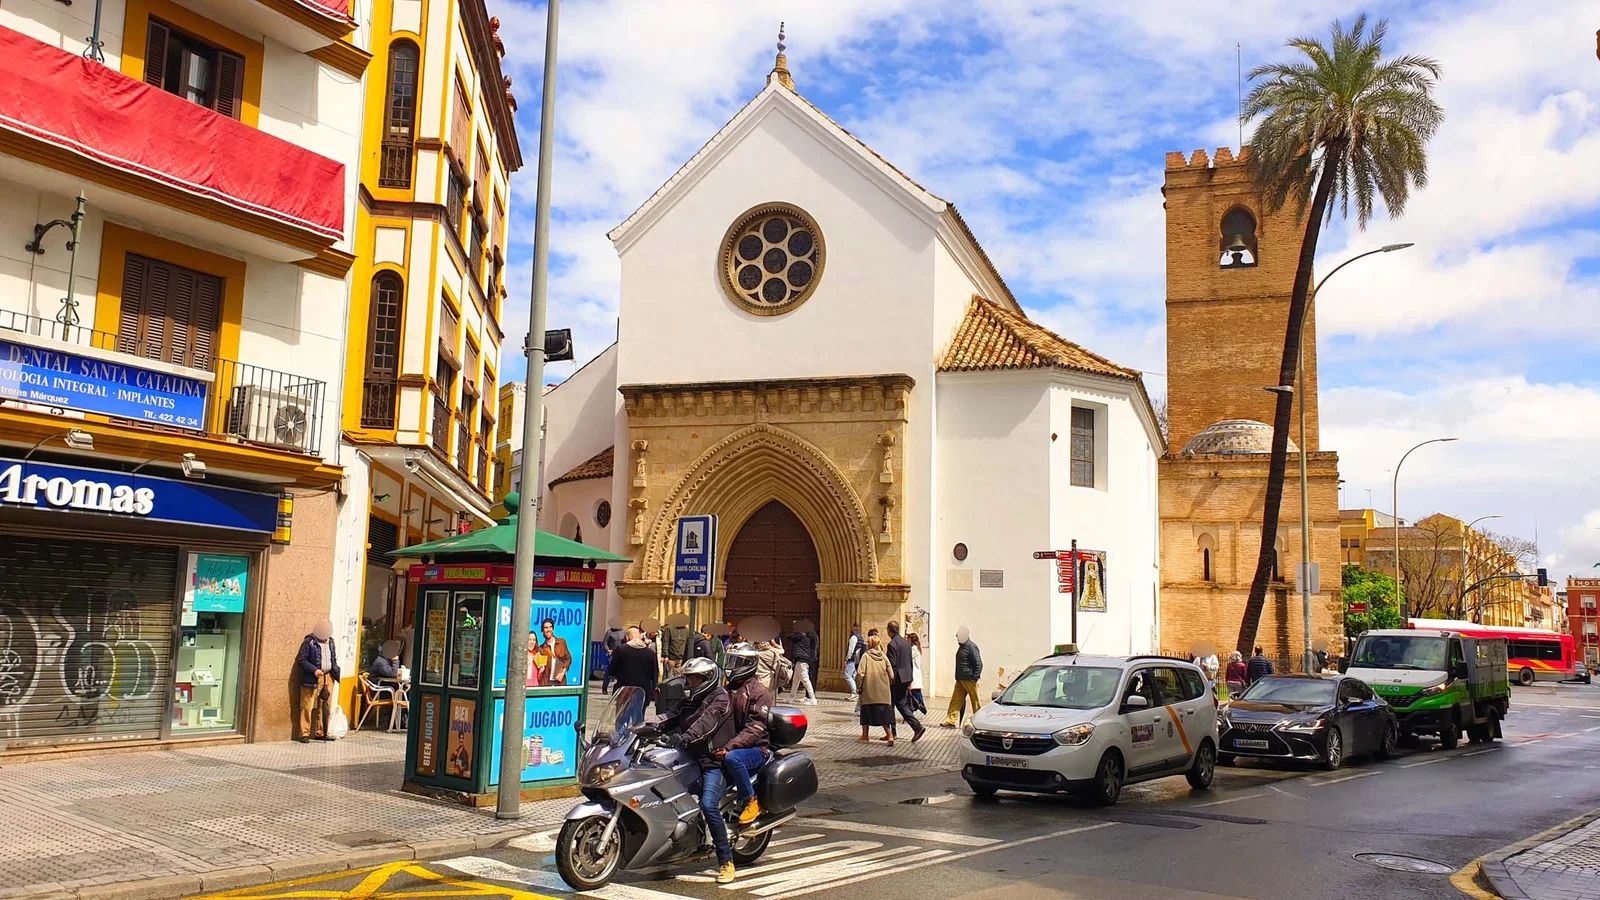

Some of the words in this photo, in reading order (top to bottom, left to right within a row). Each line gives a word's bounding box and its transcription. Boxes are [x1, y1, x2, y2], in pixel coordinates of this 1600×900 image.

[10, 345, 72, 374] DENTAL
[80, 360, 128, 385] SANTA
[136, 371, 201, 398] CATALINA
[30, 390, 69, 404] Márquez
[53, 377, 109, 398] INTEGRAL
[117, 389, 175, 409] IMPLANTES
[159, 412, 174, 422] 422
[175, 415, 186, 424] 42
[187, 417, 198, 426] 34
[0, 463, 155, 515] Aromas
[533, 606, 582, 626] JUGADO
[425, 701, 434, 741] JUGADO
[454, 705, 469, 721] BIEN
[529, 710, 573, 729] JUGADO
[423, 742, 432, 766] BIEN
